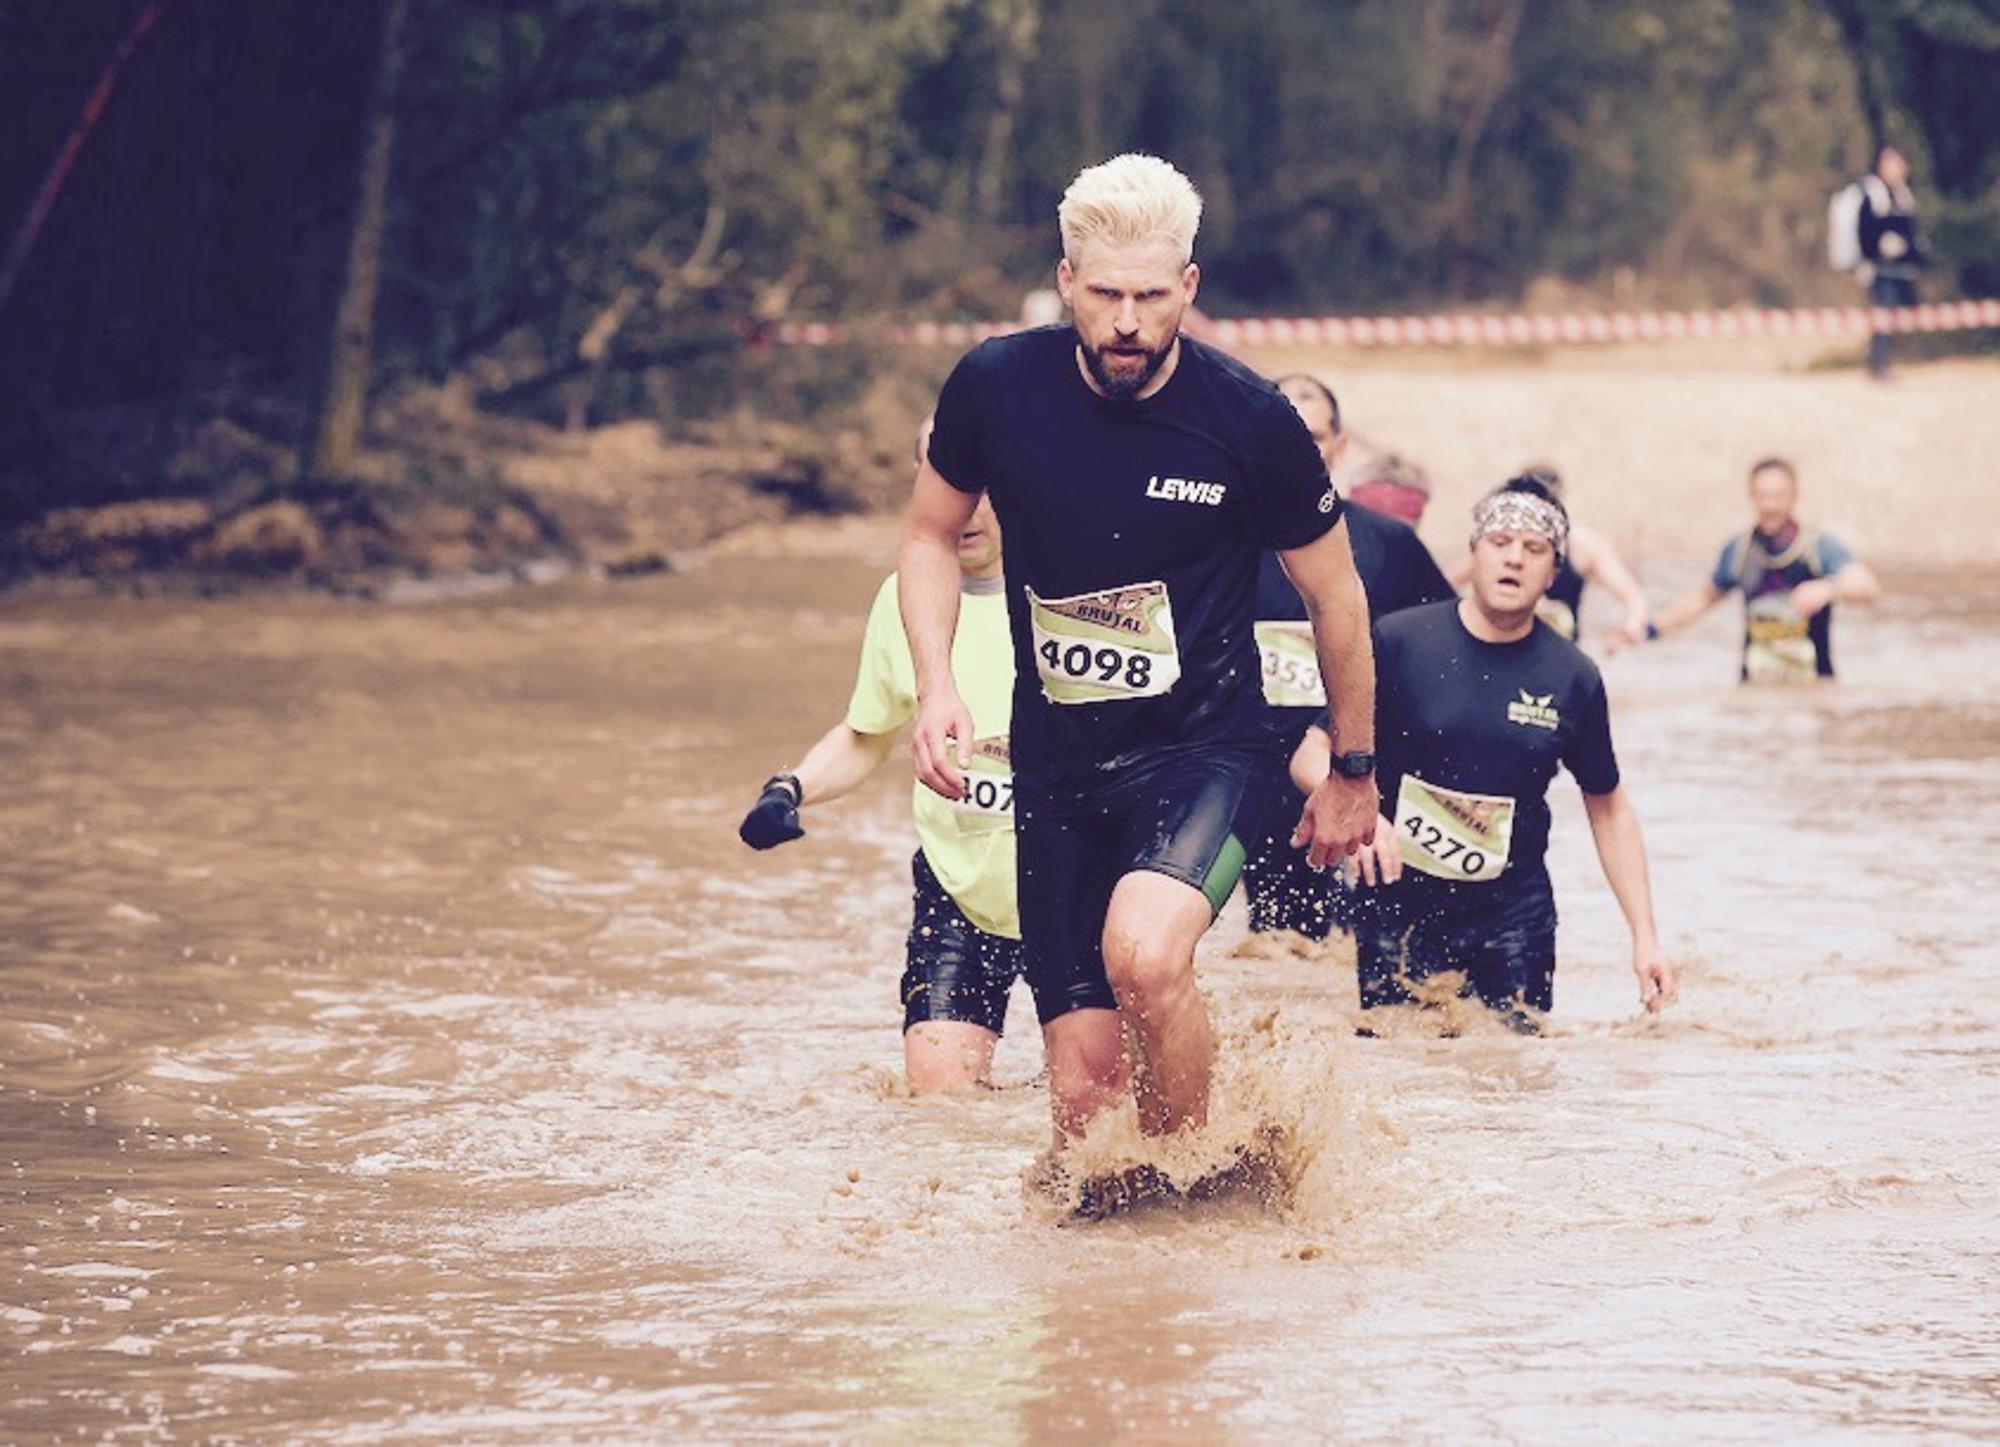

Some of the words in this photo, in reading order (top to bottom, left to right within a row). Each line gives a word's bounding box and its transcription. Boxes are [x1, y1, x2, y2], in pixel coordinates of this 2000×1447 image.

[1145, 476, 1226, 506] LEWIS
[1076, 604, 1142, 633] BRUTAL
[1040, 639, 1151, 688] 4098
[1405, 816, 1485, 874] 4270
